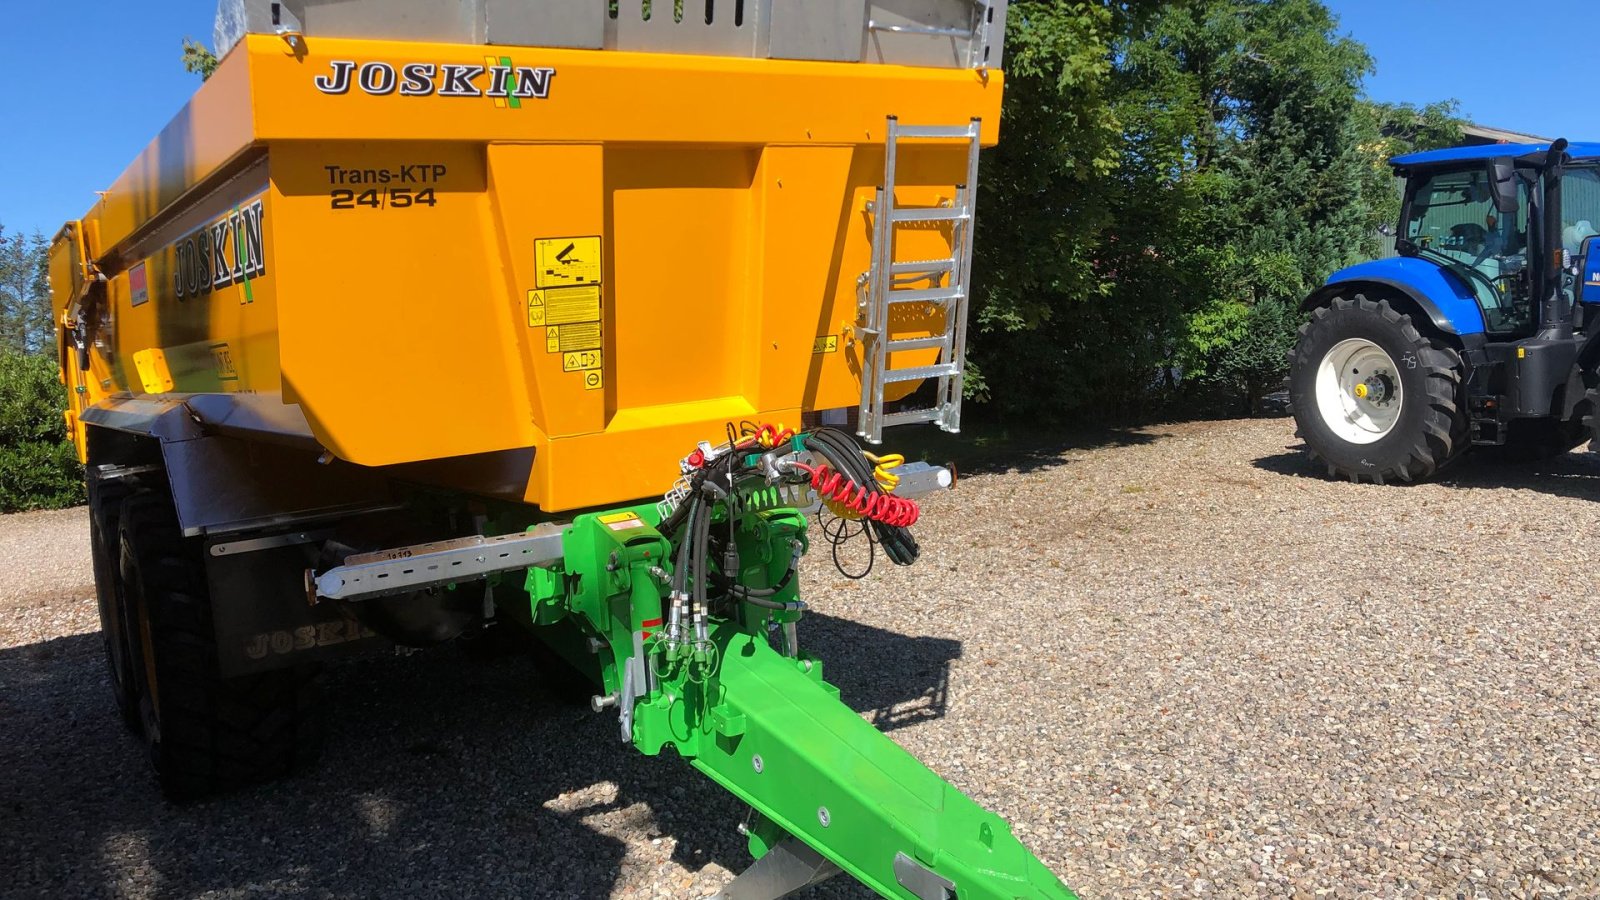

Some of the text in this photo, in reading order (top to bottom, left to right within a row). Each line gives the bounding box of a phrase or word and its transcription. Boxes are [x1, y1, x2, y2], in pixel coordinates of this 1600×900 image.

[314, 60, 556, 99] JOSKIN
[324, 165, 447, 185] Trans-KTP
[330, 187, 437, 210] 24/54
[174, 199, 266, 303] JOSKIN
[246, 619, 373, 659] JOSKI
